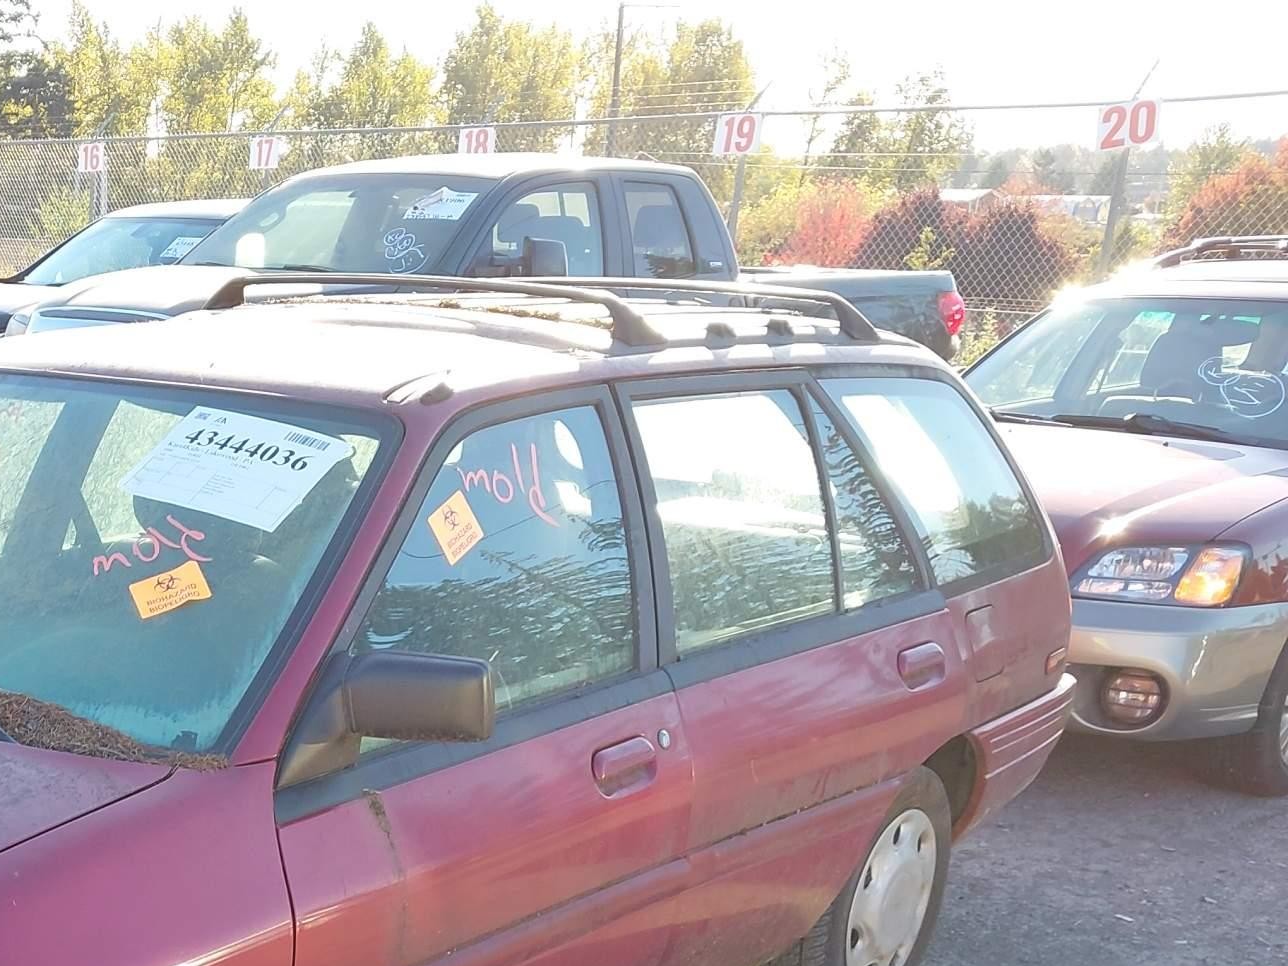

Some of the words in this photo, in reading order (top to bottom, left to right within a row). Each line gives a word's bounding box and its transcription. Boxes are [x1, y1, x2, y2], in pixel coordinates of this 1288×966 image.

[465, 129, 489, 154] 18
[723, 115, 756, 153] 19
[1100, 100, 1157, 150] 20
[83, 144, 100, 170] 16
[257, 138, 274, 167] 17
[185, 428, 315, 471] 43444036
[457, 443, 560, 527] mold
